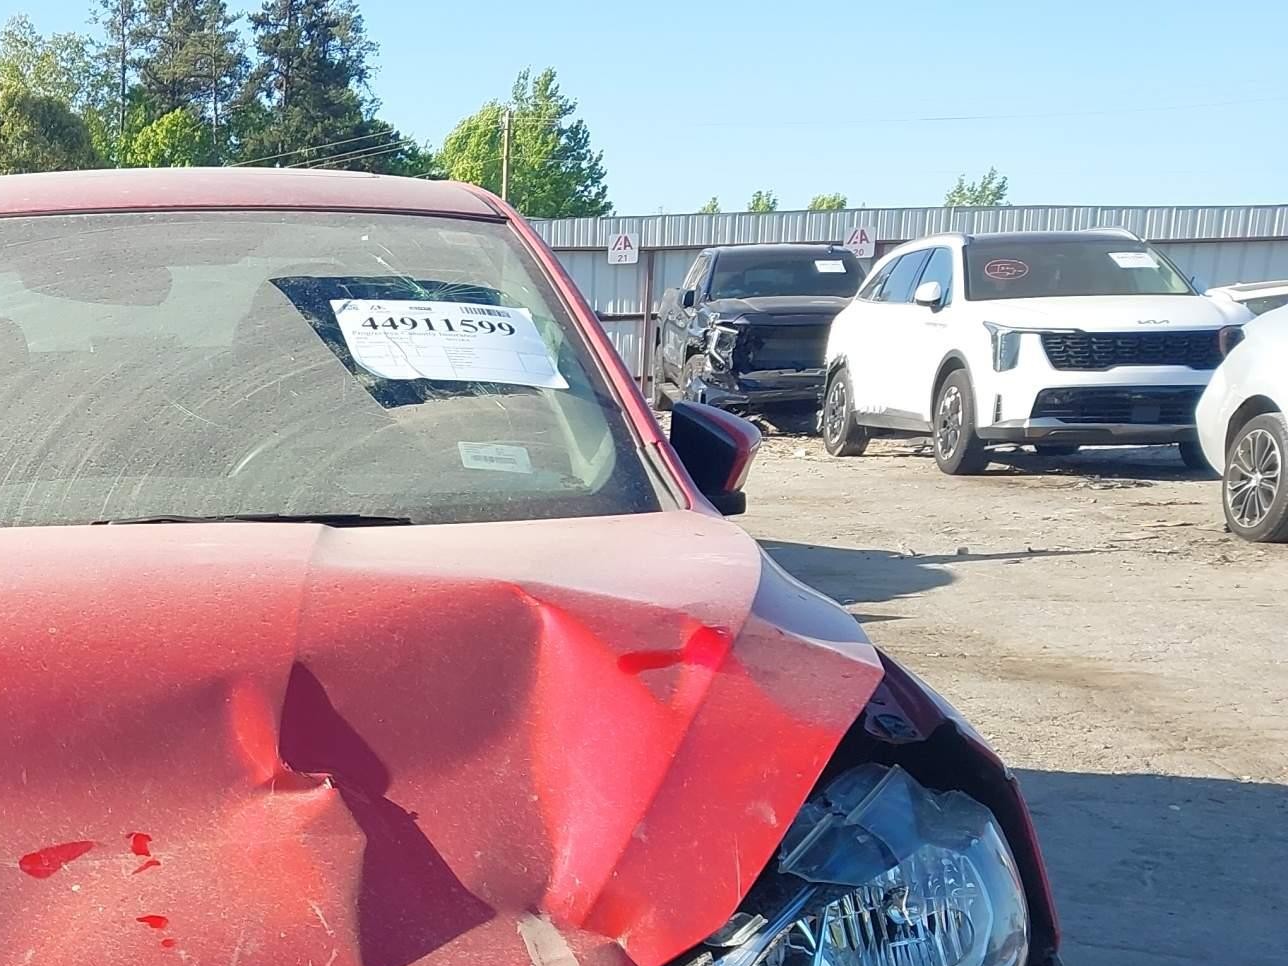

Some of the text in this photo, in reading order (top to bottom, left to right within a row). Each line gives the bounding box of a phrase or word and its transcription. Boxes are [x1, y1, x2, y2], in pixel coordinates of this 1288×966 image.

[854, 248, 865, 256] 20
[617, 254, 628, 262] 21
[361, 316, 516, 337] 44911599
